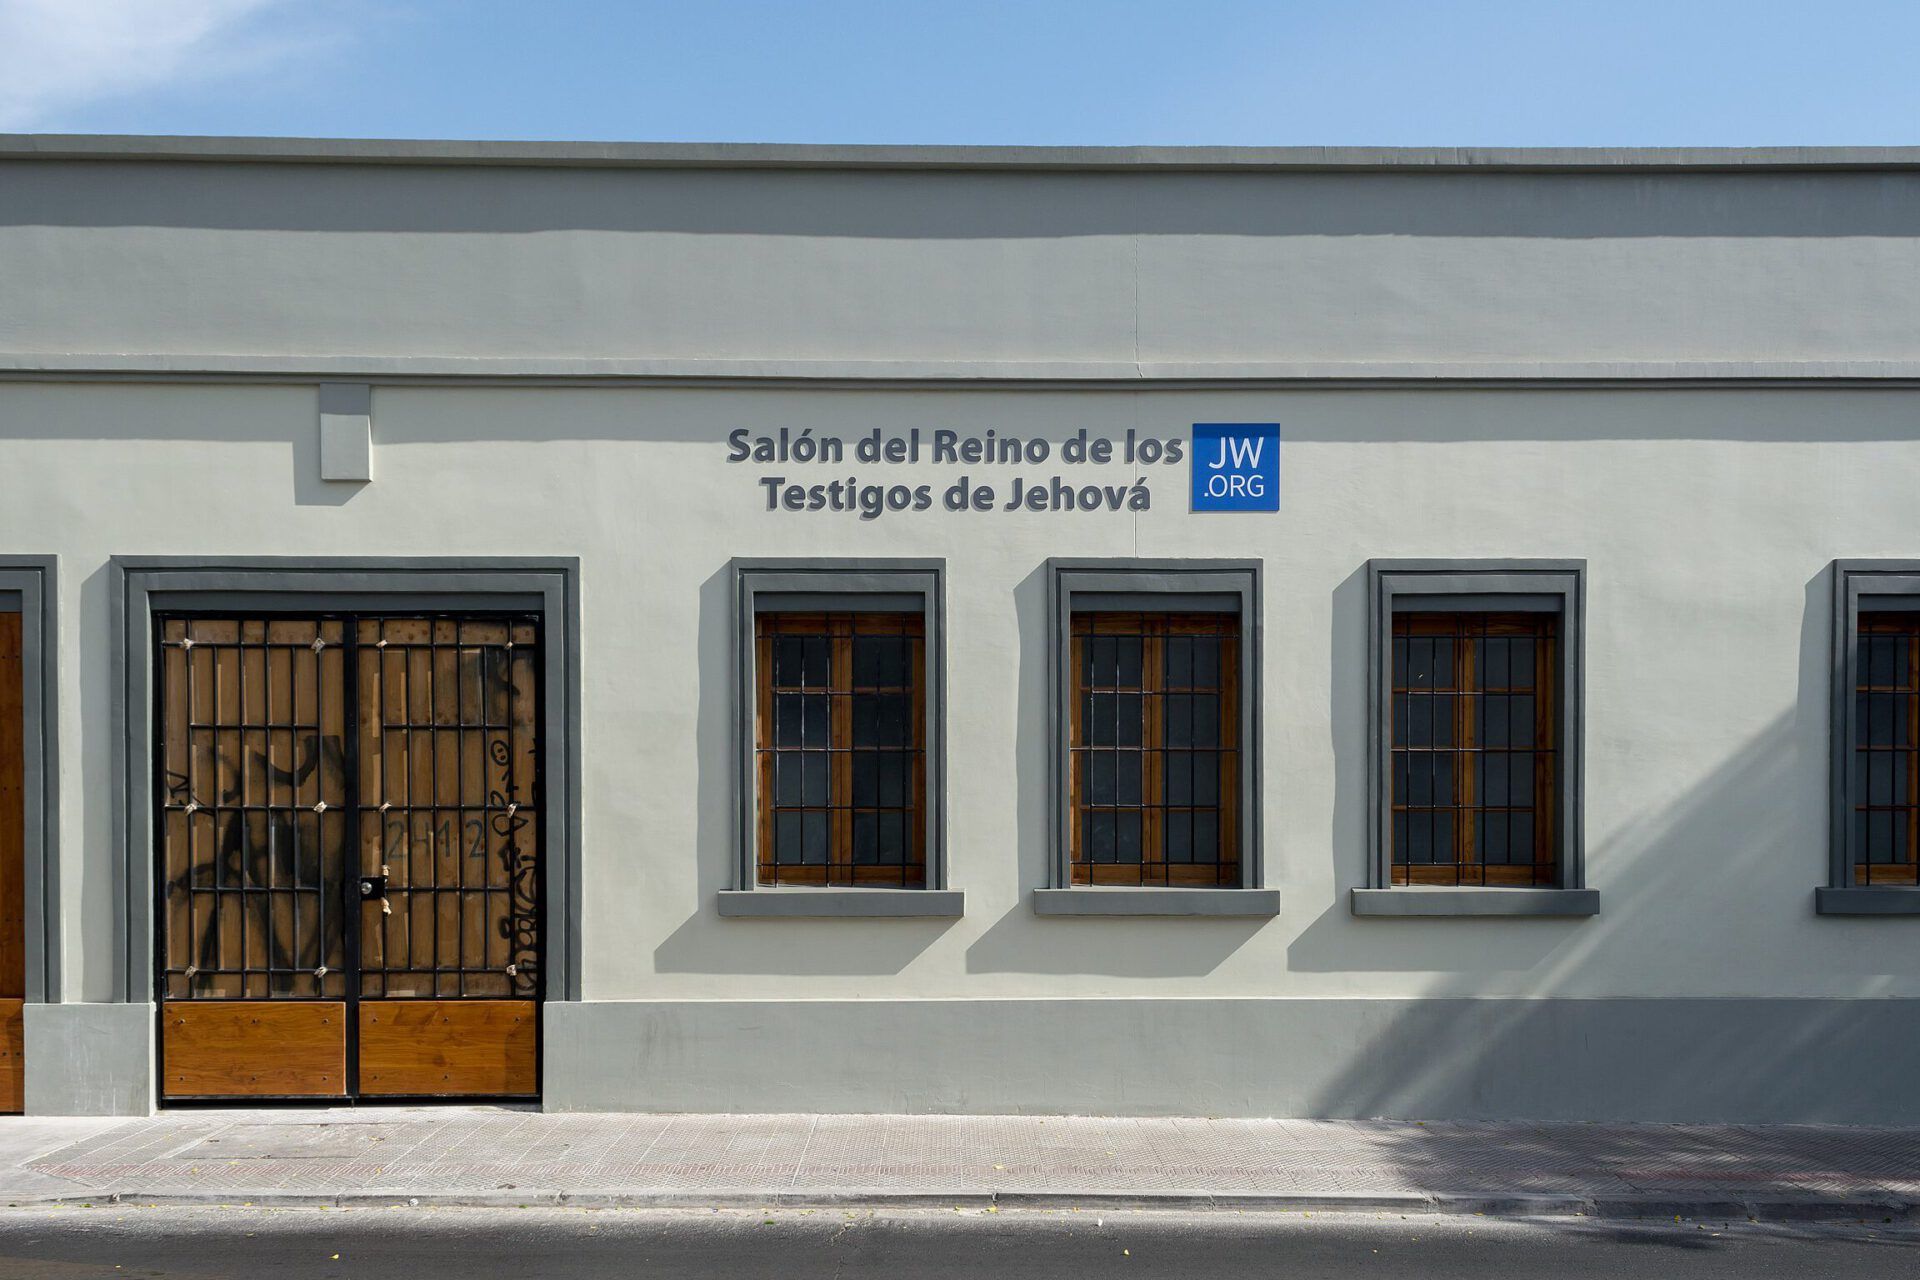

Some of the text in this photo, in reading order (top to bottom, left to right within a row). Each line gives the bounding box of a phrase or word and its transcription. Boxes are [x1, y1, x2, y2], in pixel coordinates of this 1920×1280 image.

[728, 427, 1184, 464] Salón del Reino de los
[1208, 436, 1265, 469] JW
[760, 476, 1151, 519] Testigos de Jehová
[1203, 474, 1265, 498] .ORG
